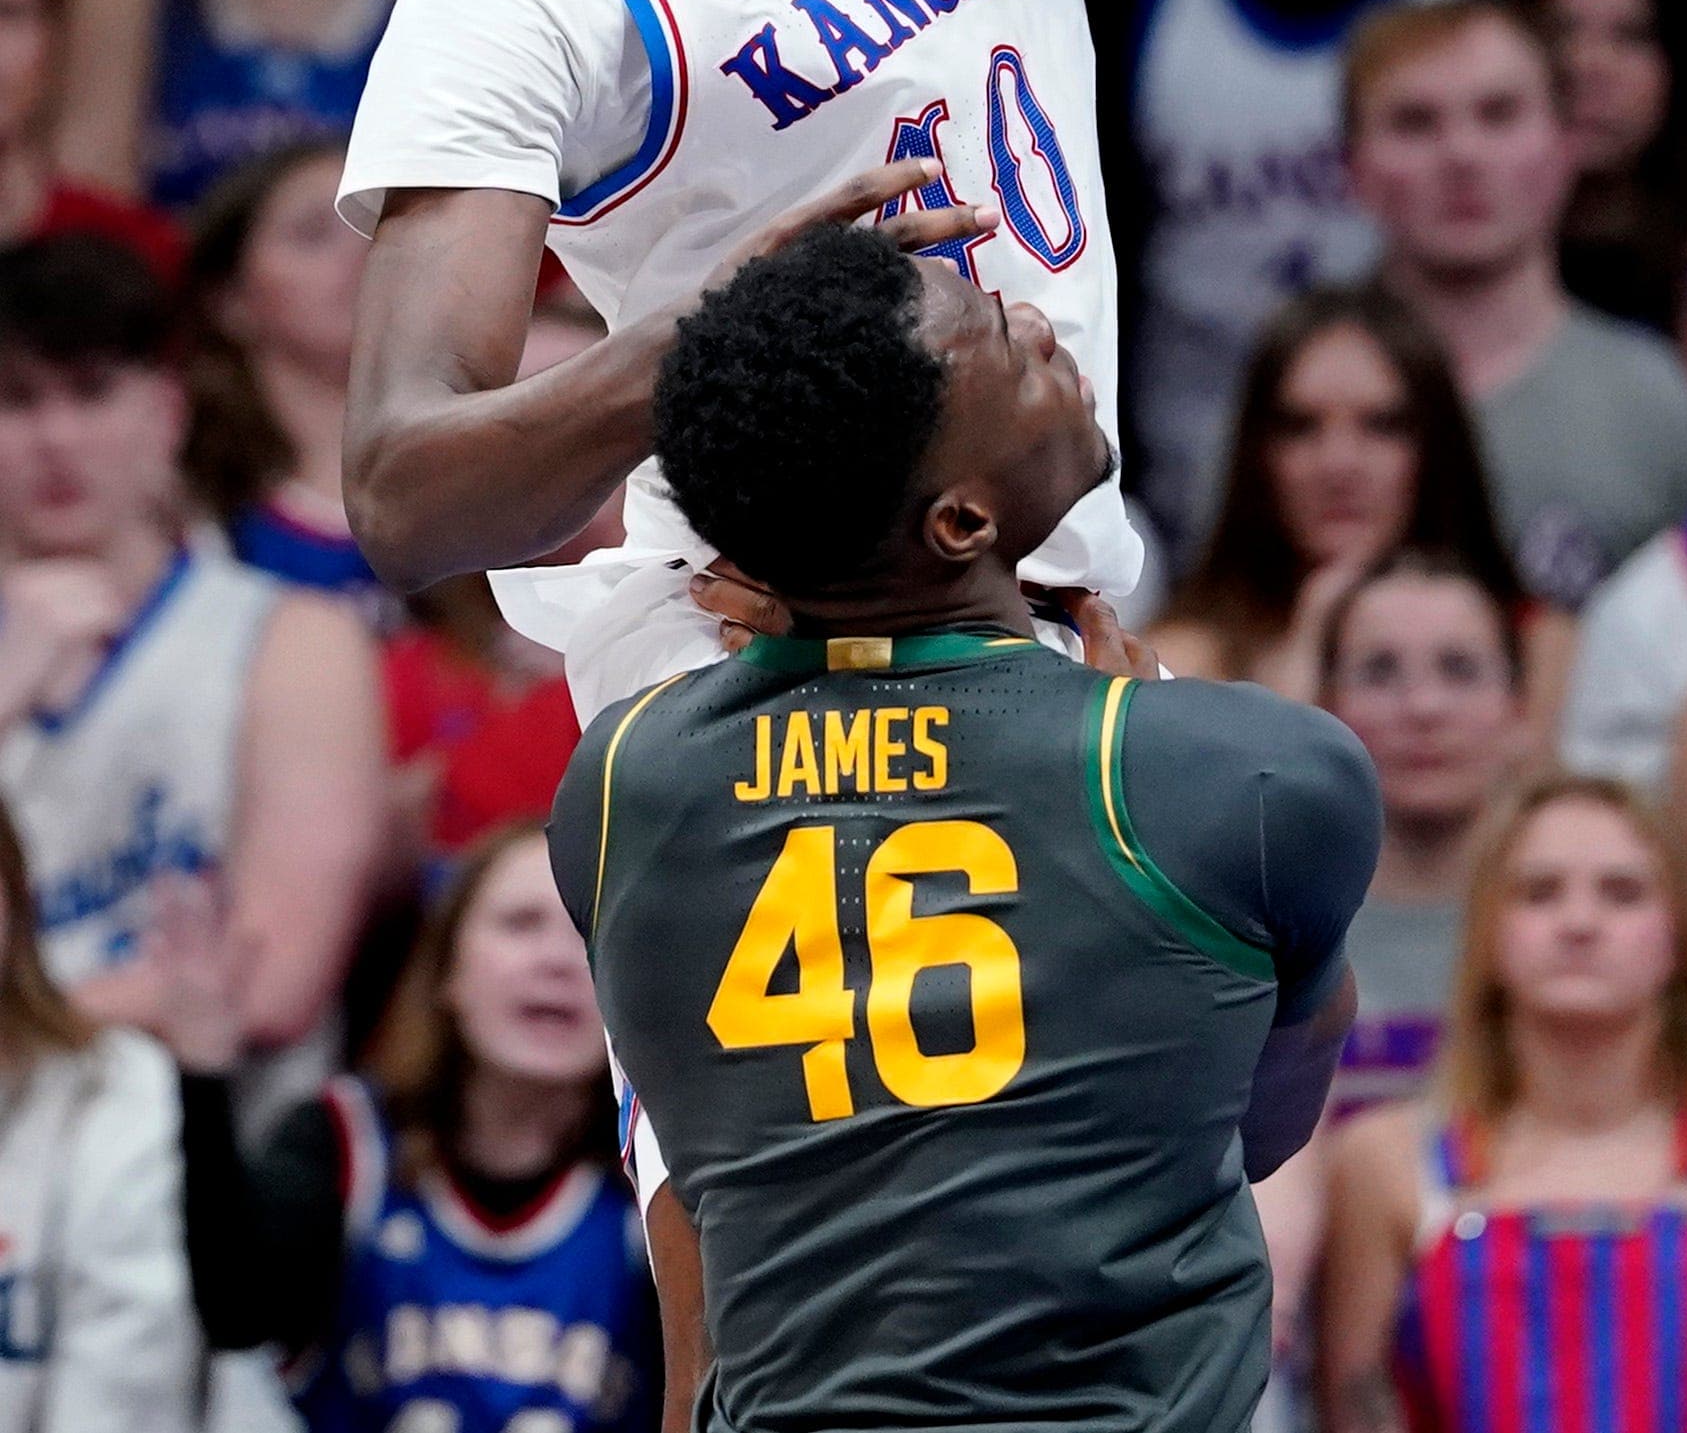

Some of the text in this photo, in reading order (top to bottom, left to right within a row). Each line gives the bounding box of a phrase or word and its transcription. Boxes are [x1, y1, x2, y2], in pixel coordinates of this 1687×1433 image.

[870, 43, 1087, 300] 40
[734, 706, 949, 802] JAMES
[705, 820, 1027, 1122] 46
